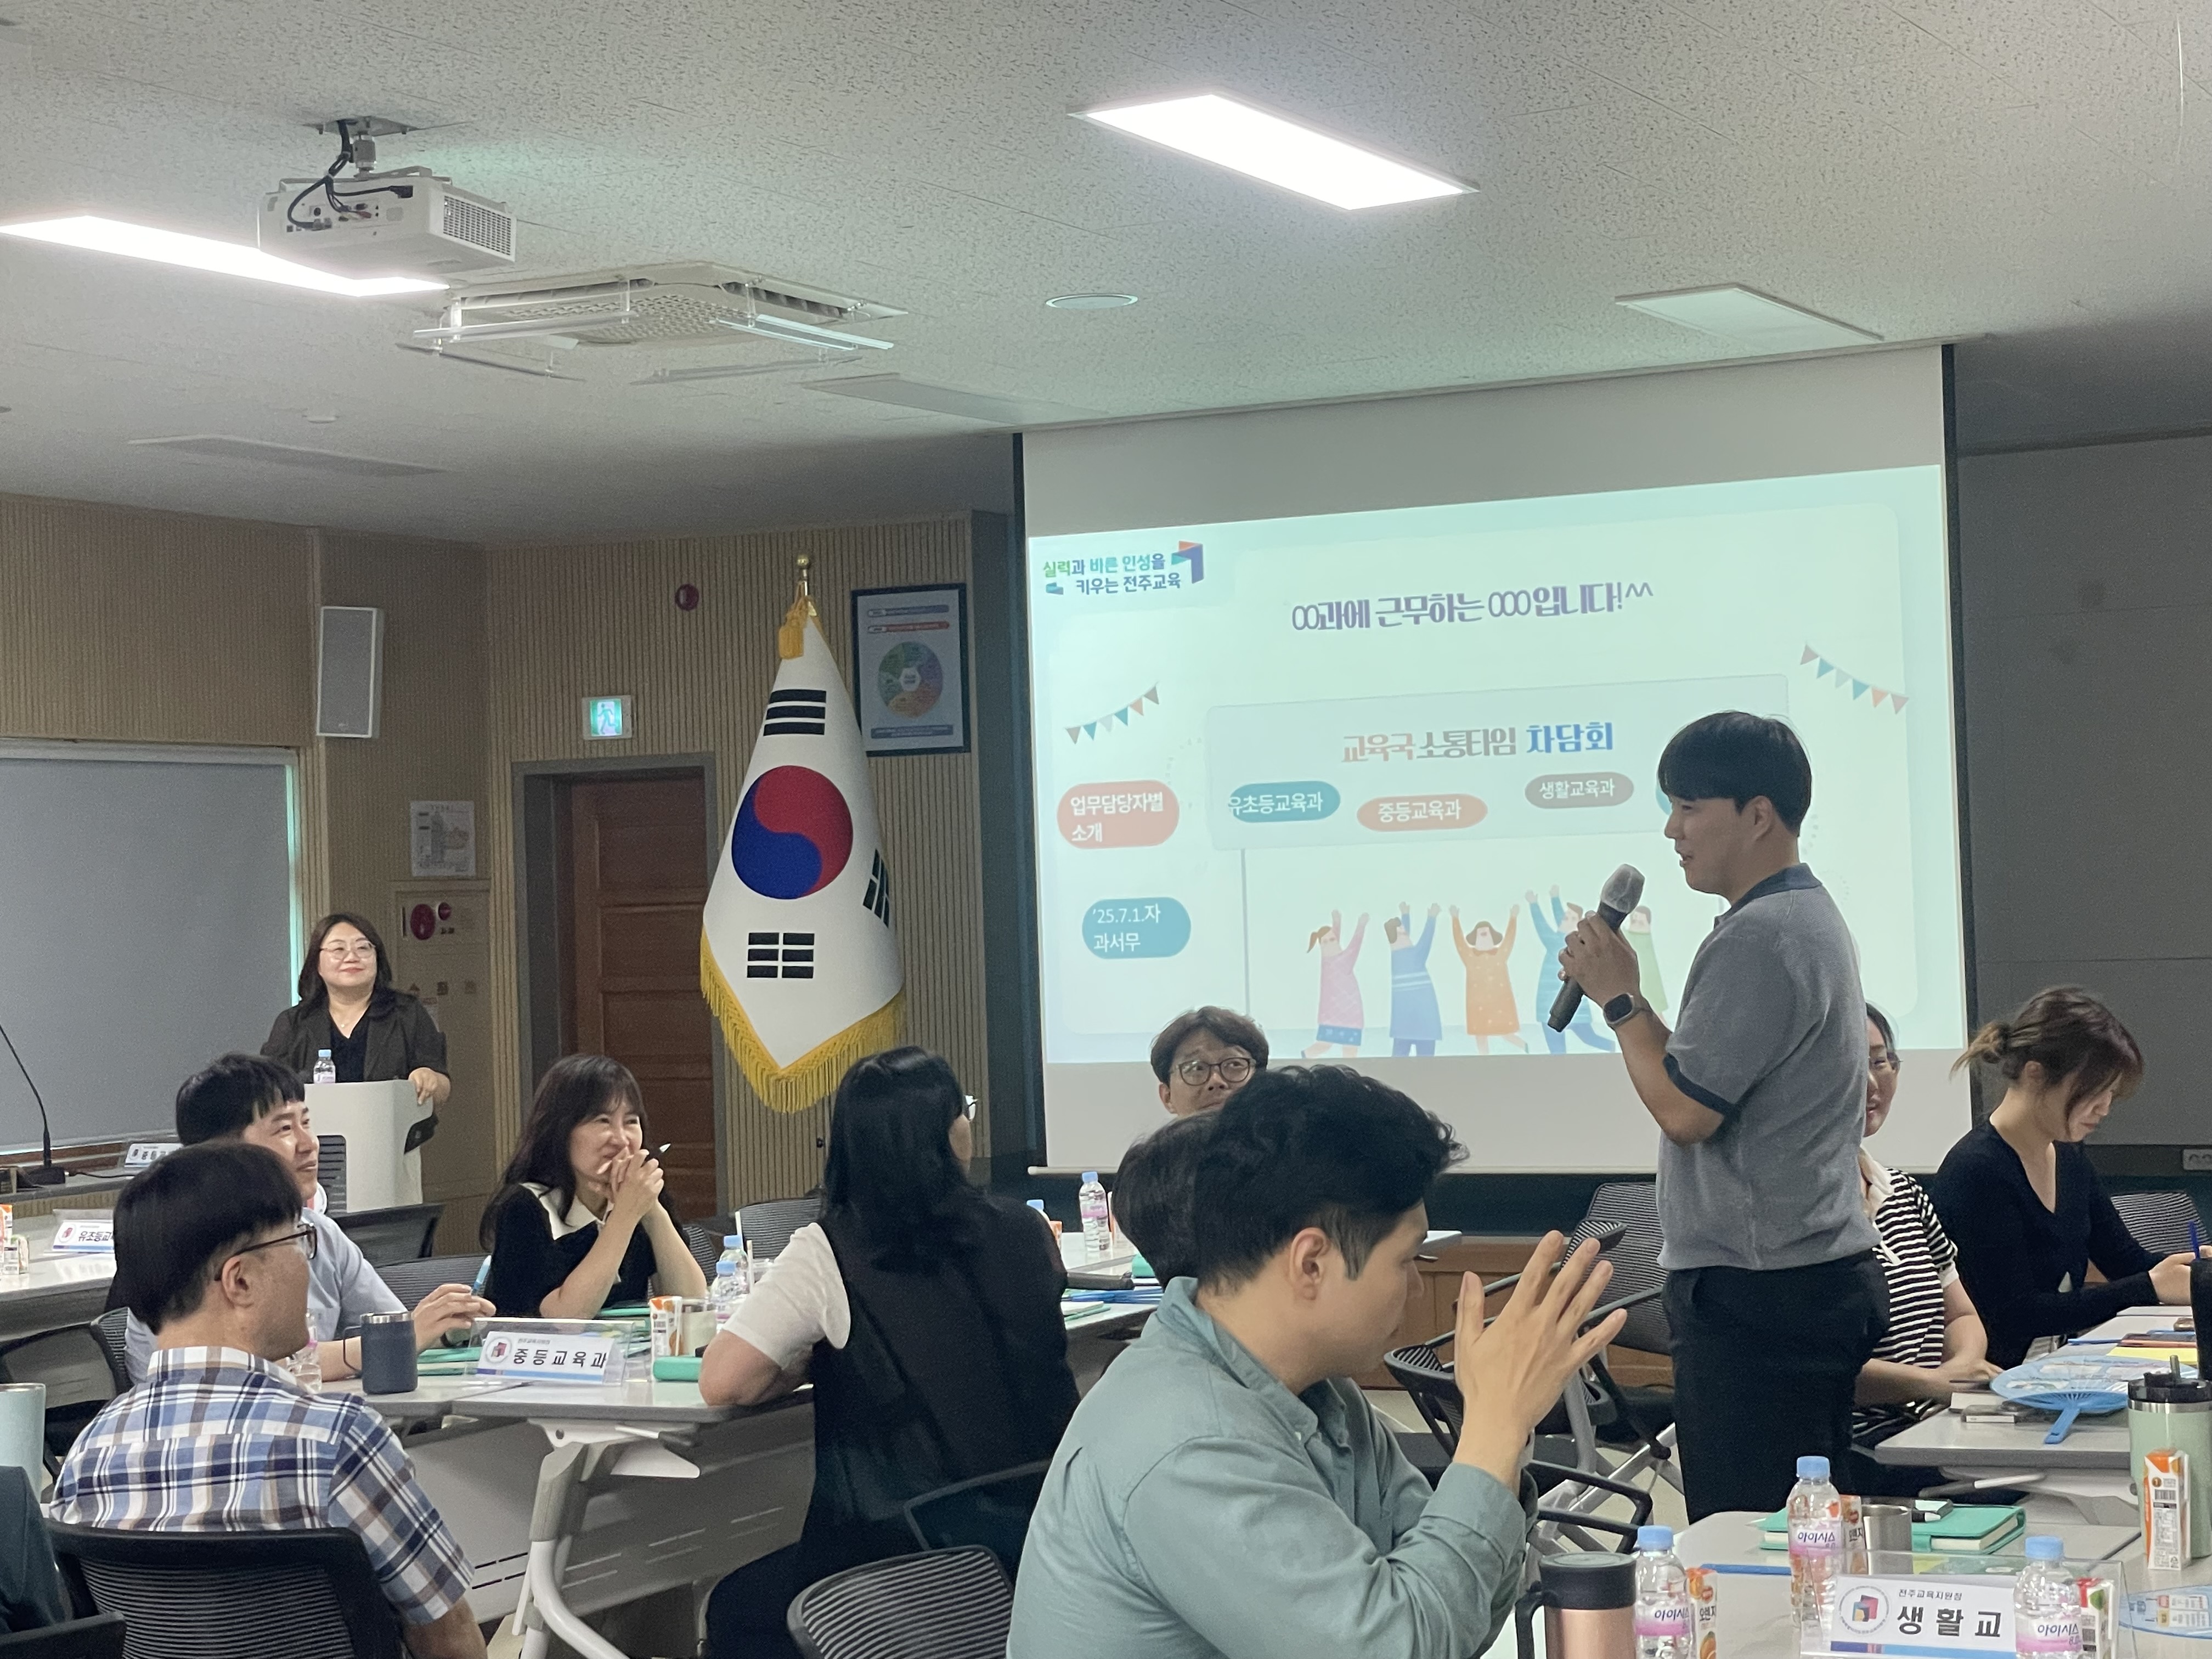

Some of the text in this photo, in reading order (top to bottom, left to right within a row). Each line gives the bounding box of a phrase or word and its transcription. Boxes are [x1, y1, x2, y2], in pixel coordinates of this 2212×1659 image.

[1043, 553, 1165, 578] 실력과 바른 인성을
[1076, 572, 1181, 595] 키우는 전주교육
[1375, 592, 1485, 627] 근무하는
[1341, 721, 1613, 762] 교육국 소통타임 차담회
[1539, 778, 1615, 799] 생활교육과
[1070, 792, 1164, 816] 업무담당자별
[1378, 799, 1462, 823] 중등교육과
[1071, 823, 1103, 843] 소개
[1094, 933, 1141, 952] 과서무
[78, 1231, 114, 1242] 유초등교
[514, 1348, 607, 1369] 중등교육과
